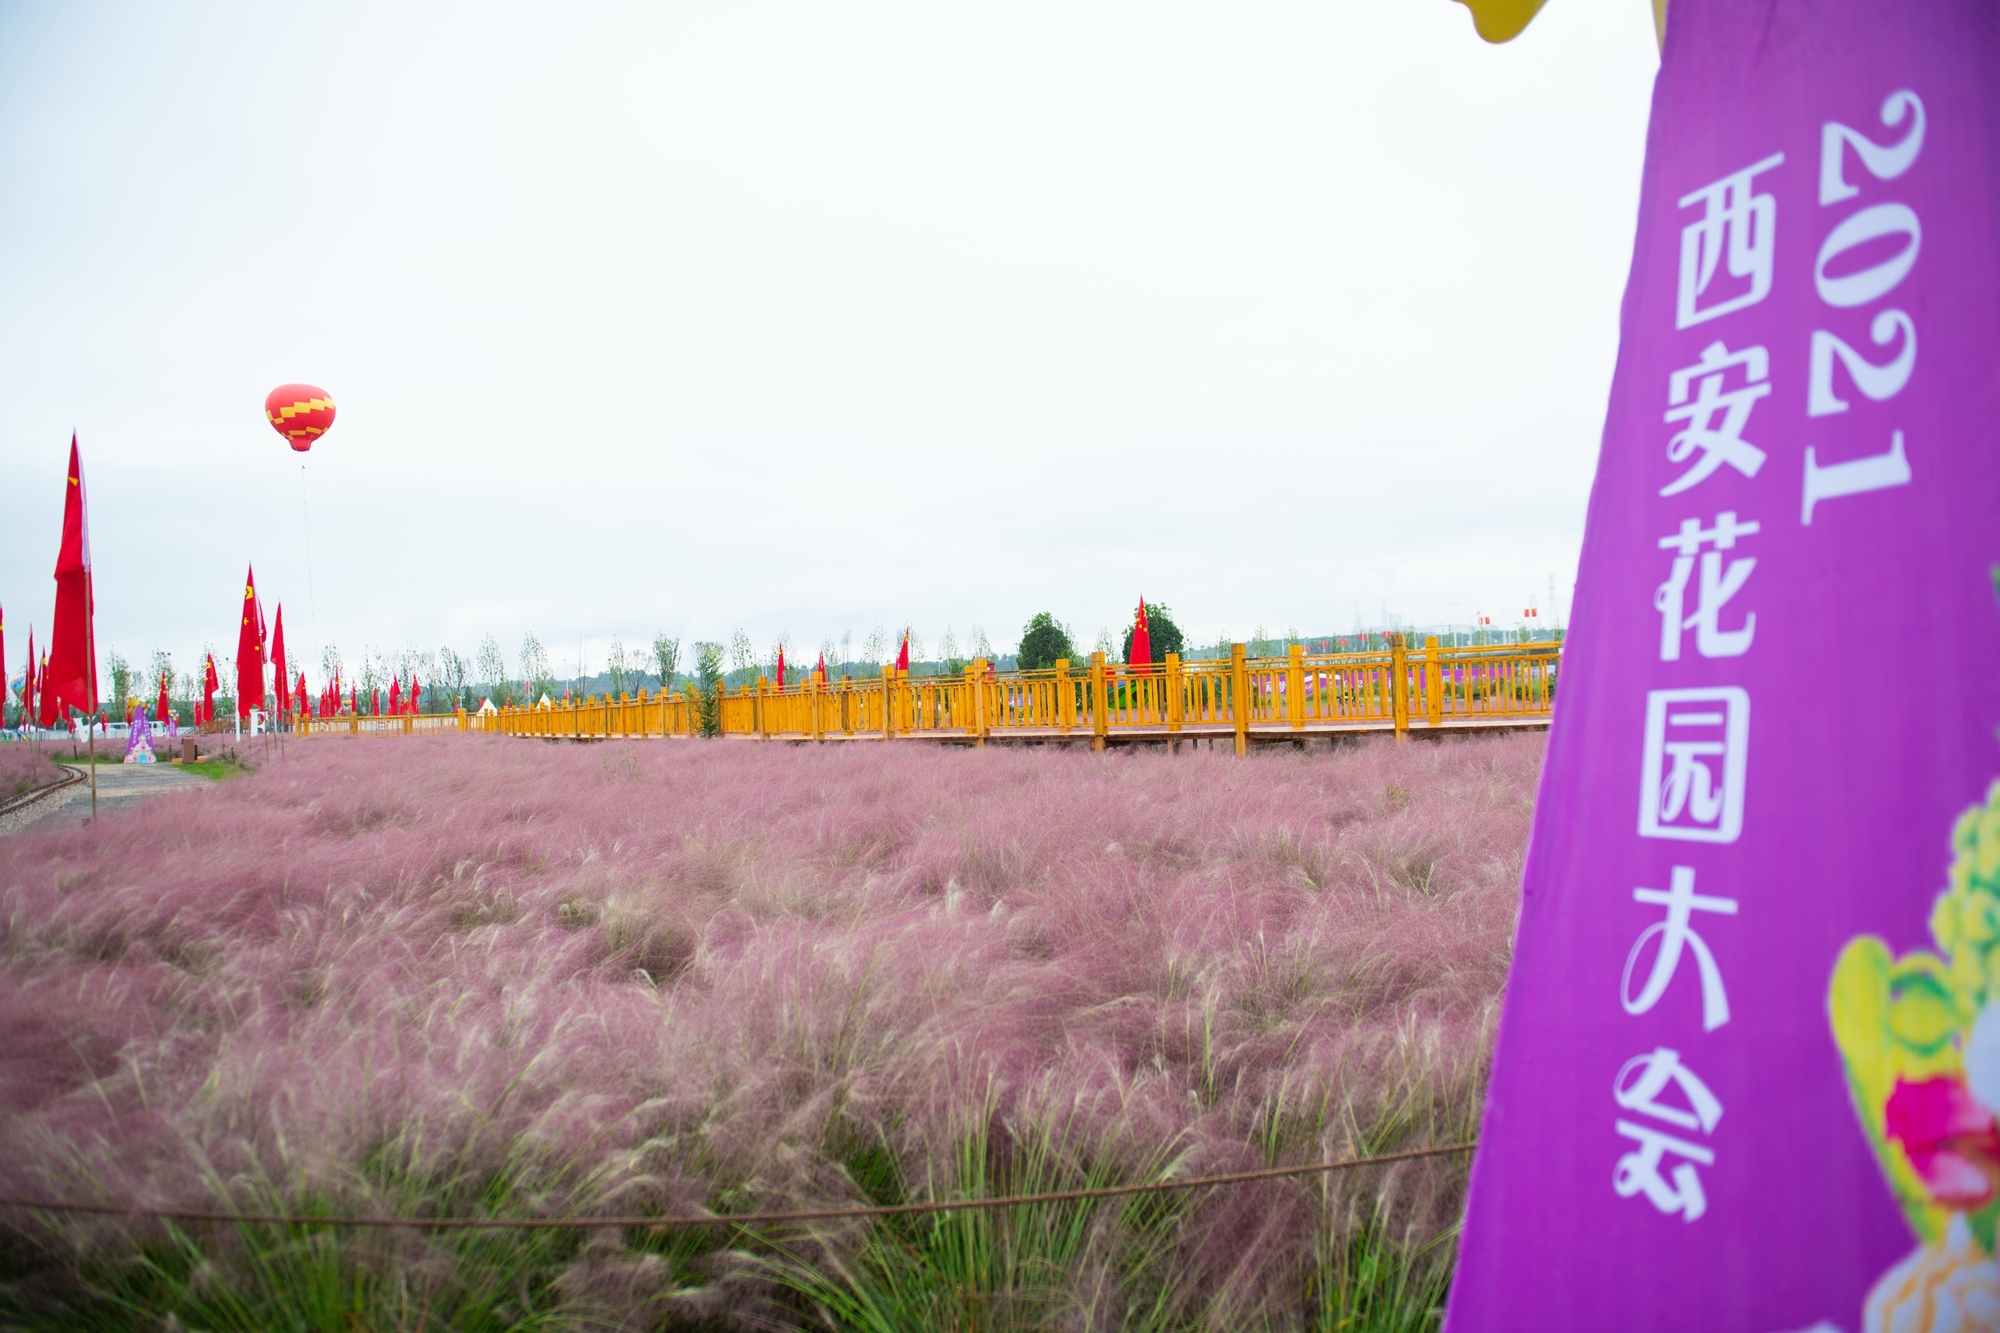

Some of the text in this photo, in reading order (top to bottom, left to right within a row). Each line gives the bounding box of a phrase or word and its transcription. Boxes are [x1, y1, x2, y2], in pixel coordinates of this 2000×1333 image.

[1803, 89, 1925, 526] 2021
[1614, 152, 1785, 1222] 西安花园大会
